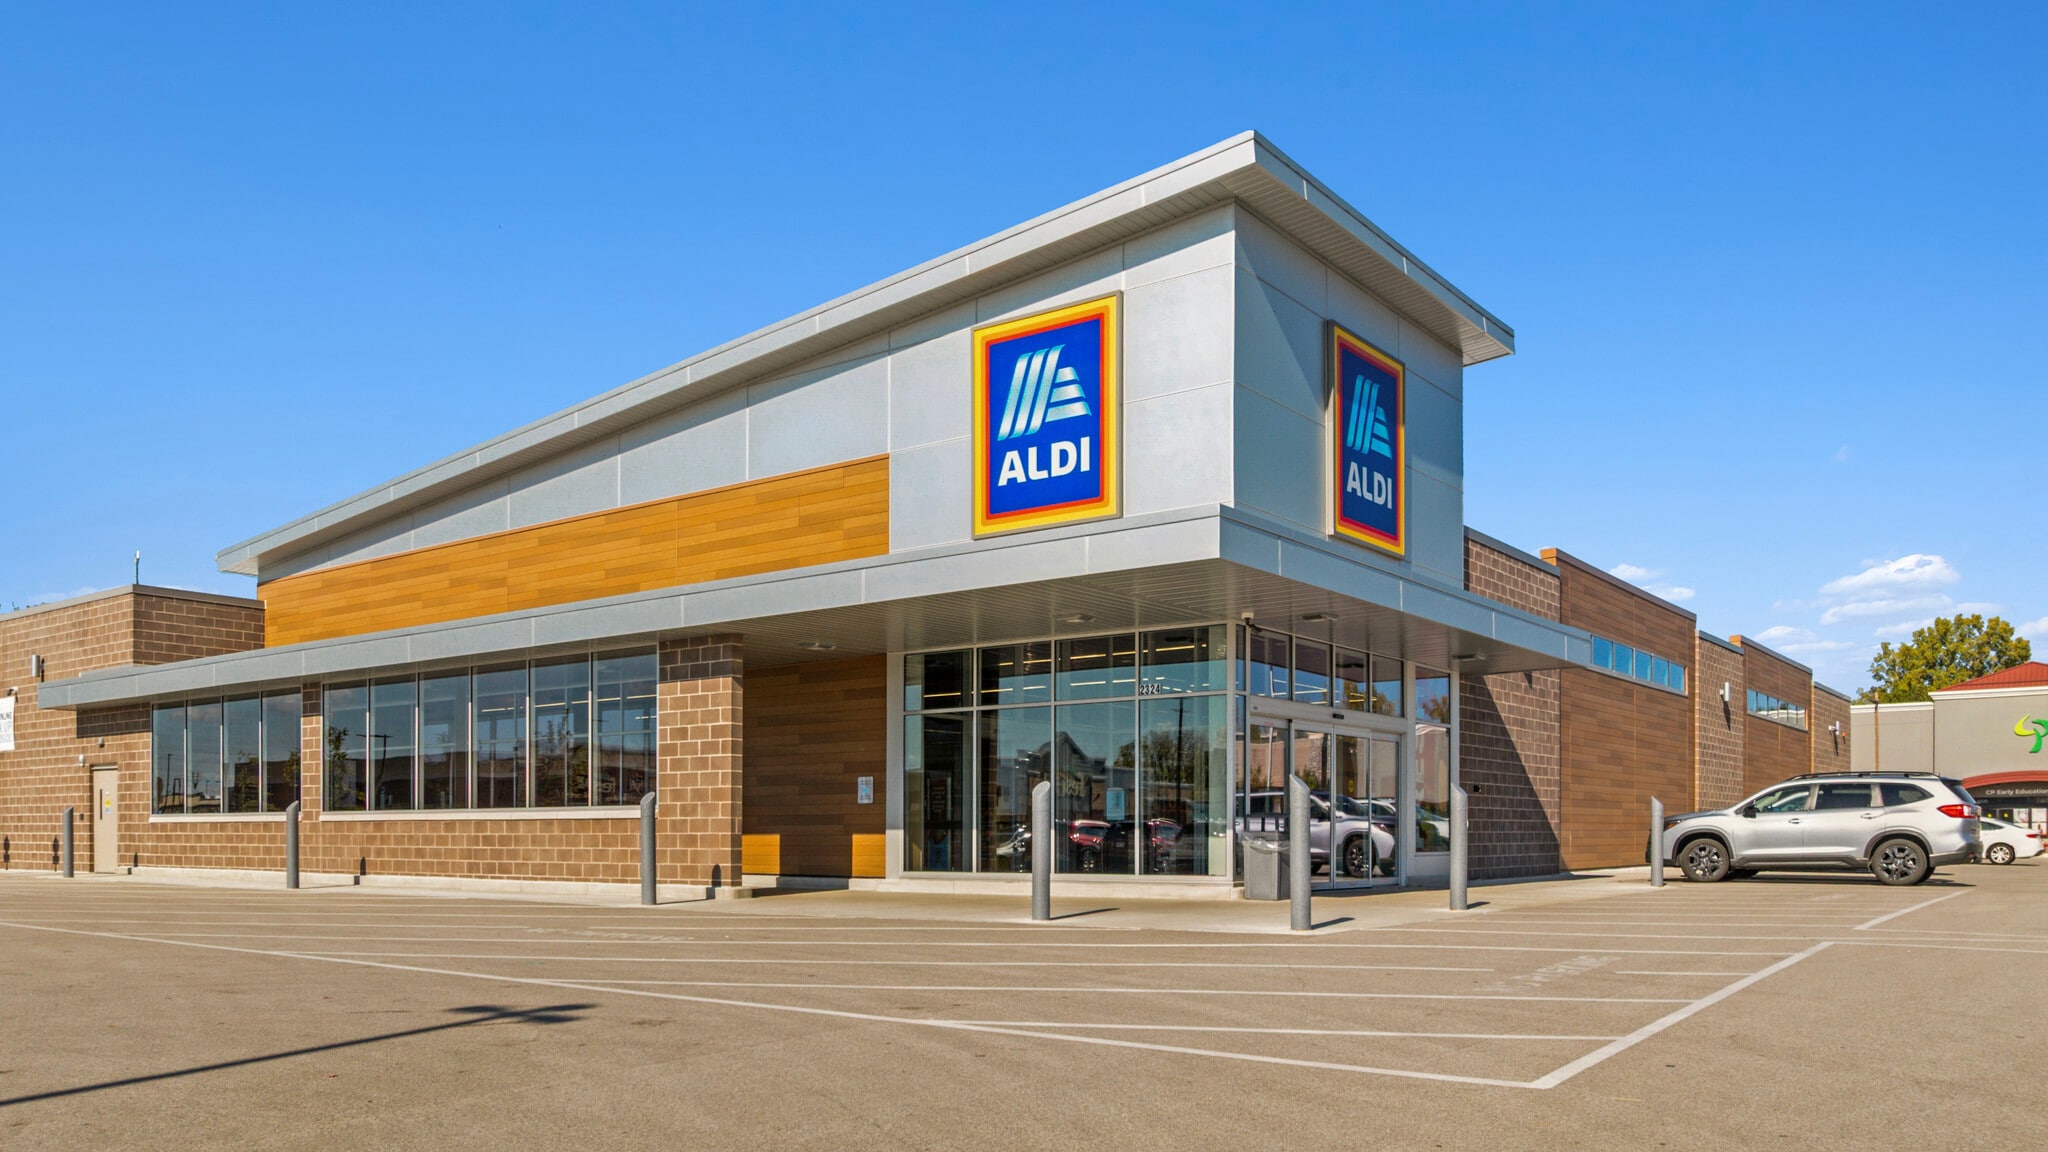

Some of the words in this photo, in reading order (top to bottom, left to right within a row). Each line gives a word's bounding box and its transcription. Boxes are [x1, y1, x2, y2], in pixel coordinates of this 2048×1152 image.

[998, 436, 1090, 486] ALDI
[1347, 461, 1392, 509] ALDI
[1140, 684, 1160, 695] 2324
